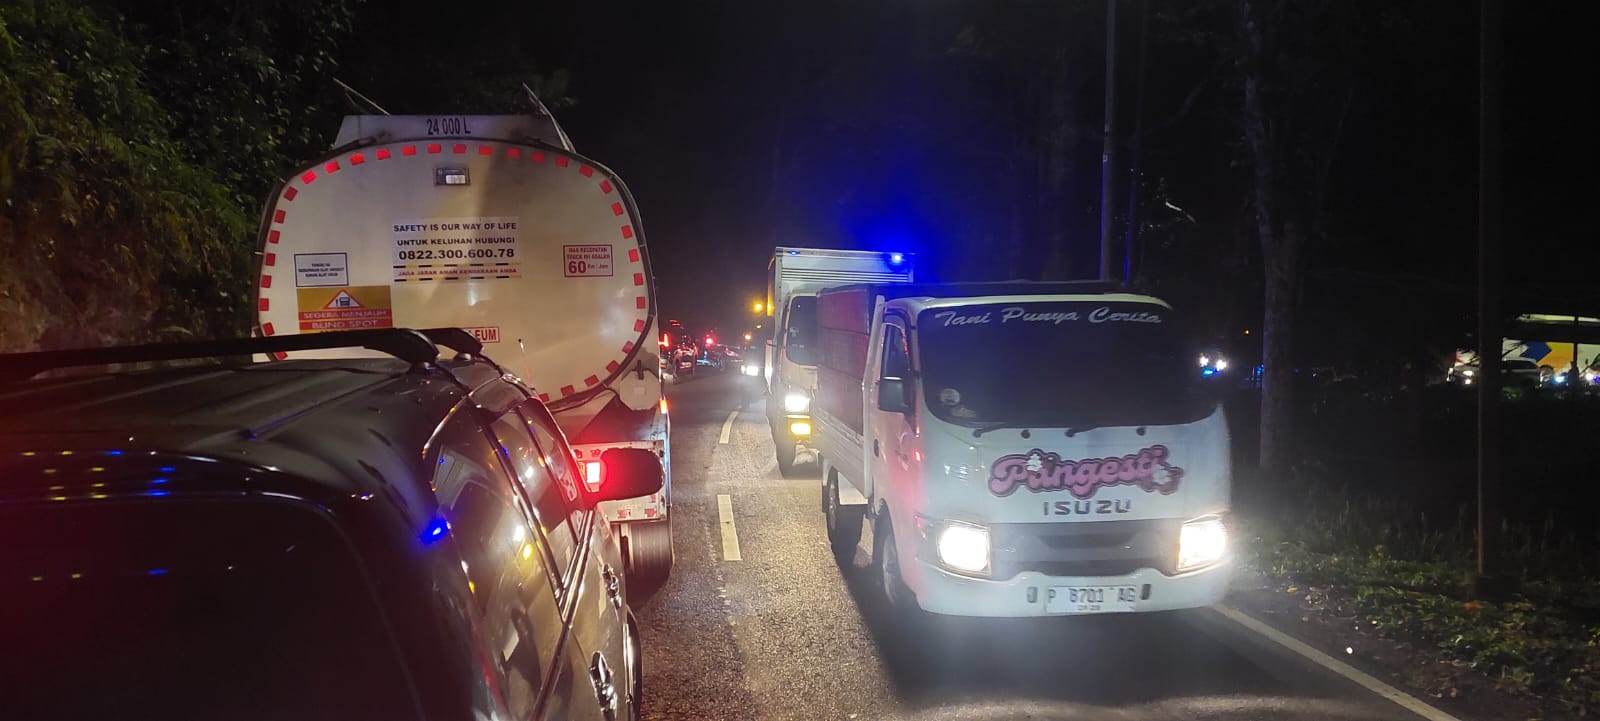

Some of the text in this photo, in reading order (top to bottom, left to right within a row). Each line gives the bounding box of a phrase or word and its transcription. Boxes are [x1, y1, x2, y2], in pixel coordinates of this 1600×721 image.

[426, 117, 471, 135] 24 000 L
[393, 224, 428, 232] SAFETY
[441, 223, 460, 231] OUR
[462, 223, 481, 231] WAY
[498, 222, 517, 230] LIFE
[398, 248, 515, 260] 0822.300.600.78
[568, 260, 587, 274] 60
[303, 311, 340, 319] SEGERA
[935, 306, 1162, 327] Tani Punya Cerita
[311, 319, 378, 329] BLIND SPOT
[469, 329, 497, 341] EUM
[1043, 499, 1131, 516] ISUZU
[1047, 588, 1057, 603] P
